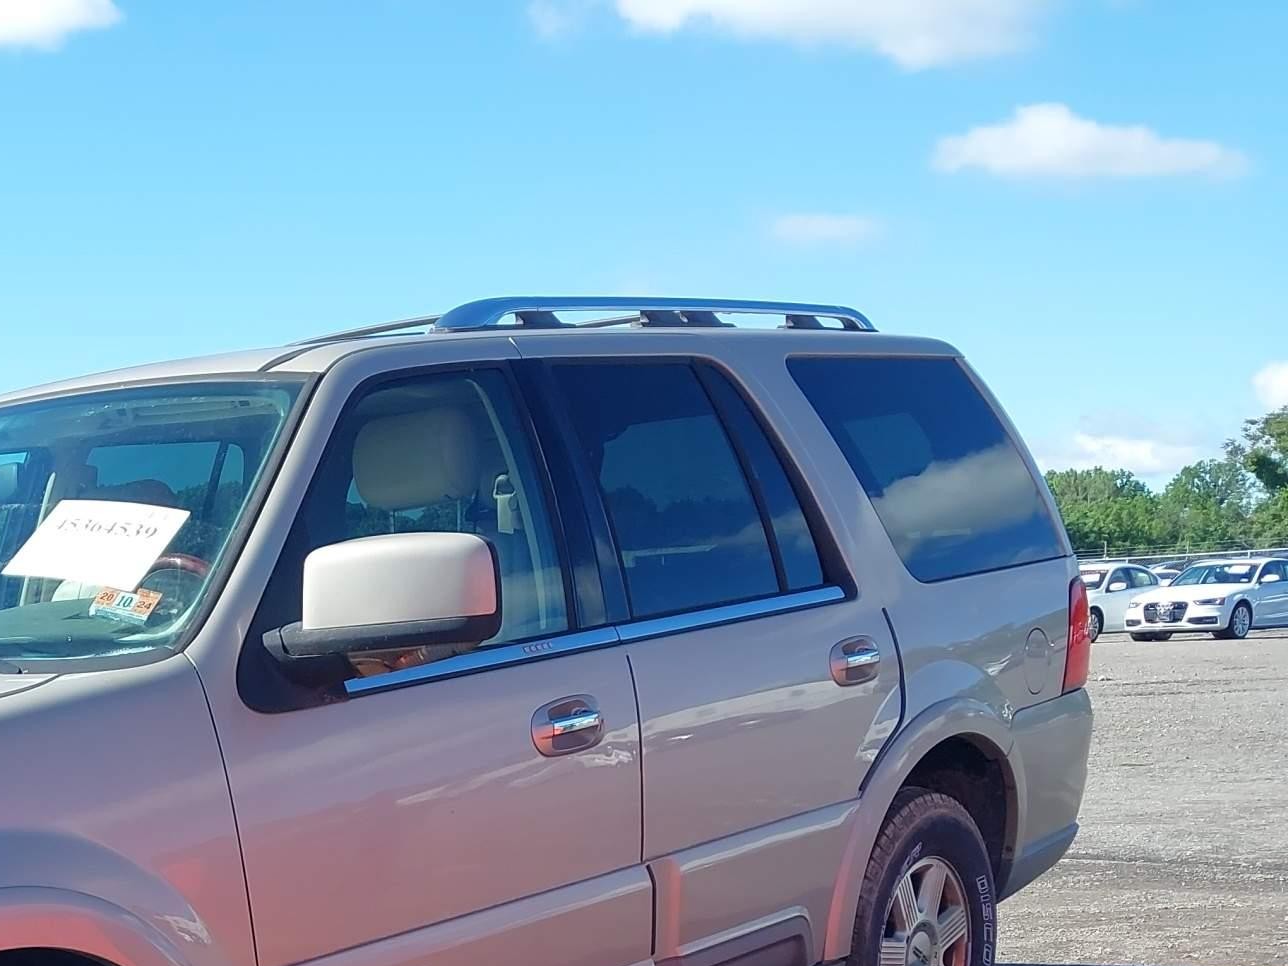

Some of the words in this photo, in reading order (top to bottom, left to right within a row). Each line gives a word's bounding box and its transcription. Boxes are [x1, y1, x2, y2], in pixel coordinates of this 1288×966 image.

[99, 591, 114, 602] 20
[115, 595, 133, 608] 10
[136, 600, 153, 610] 24
